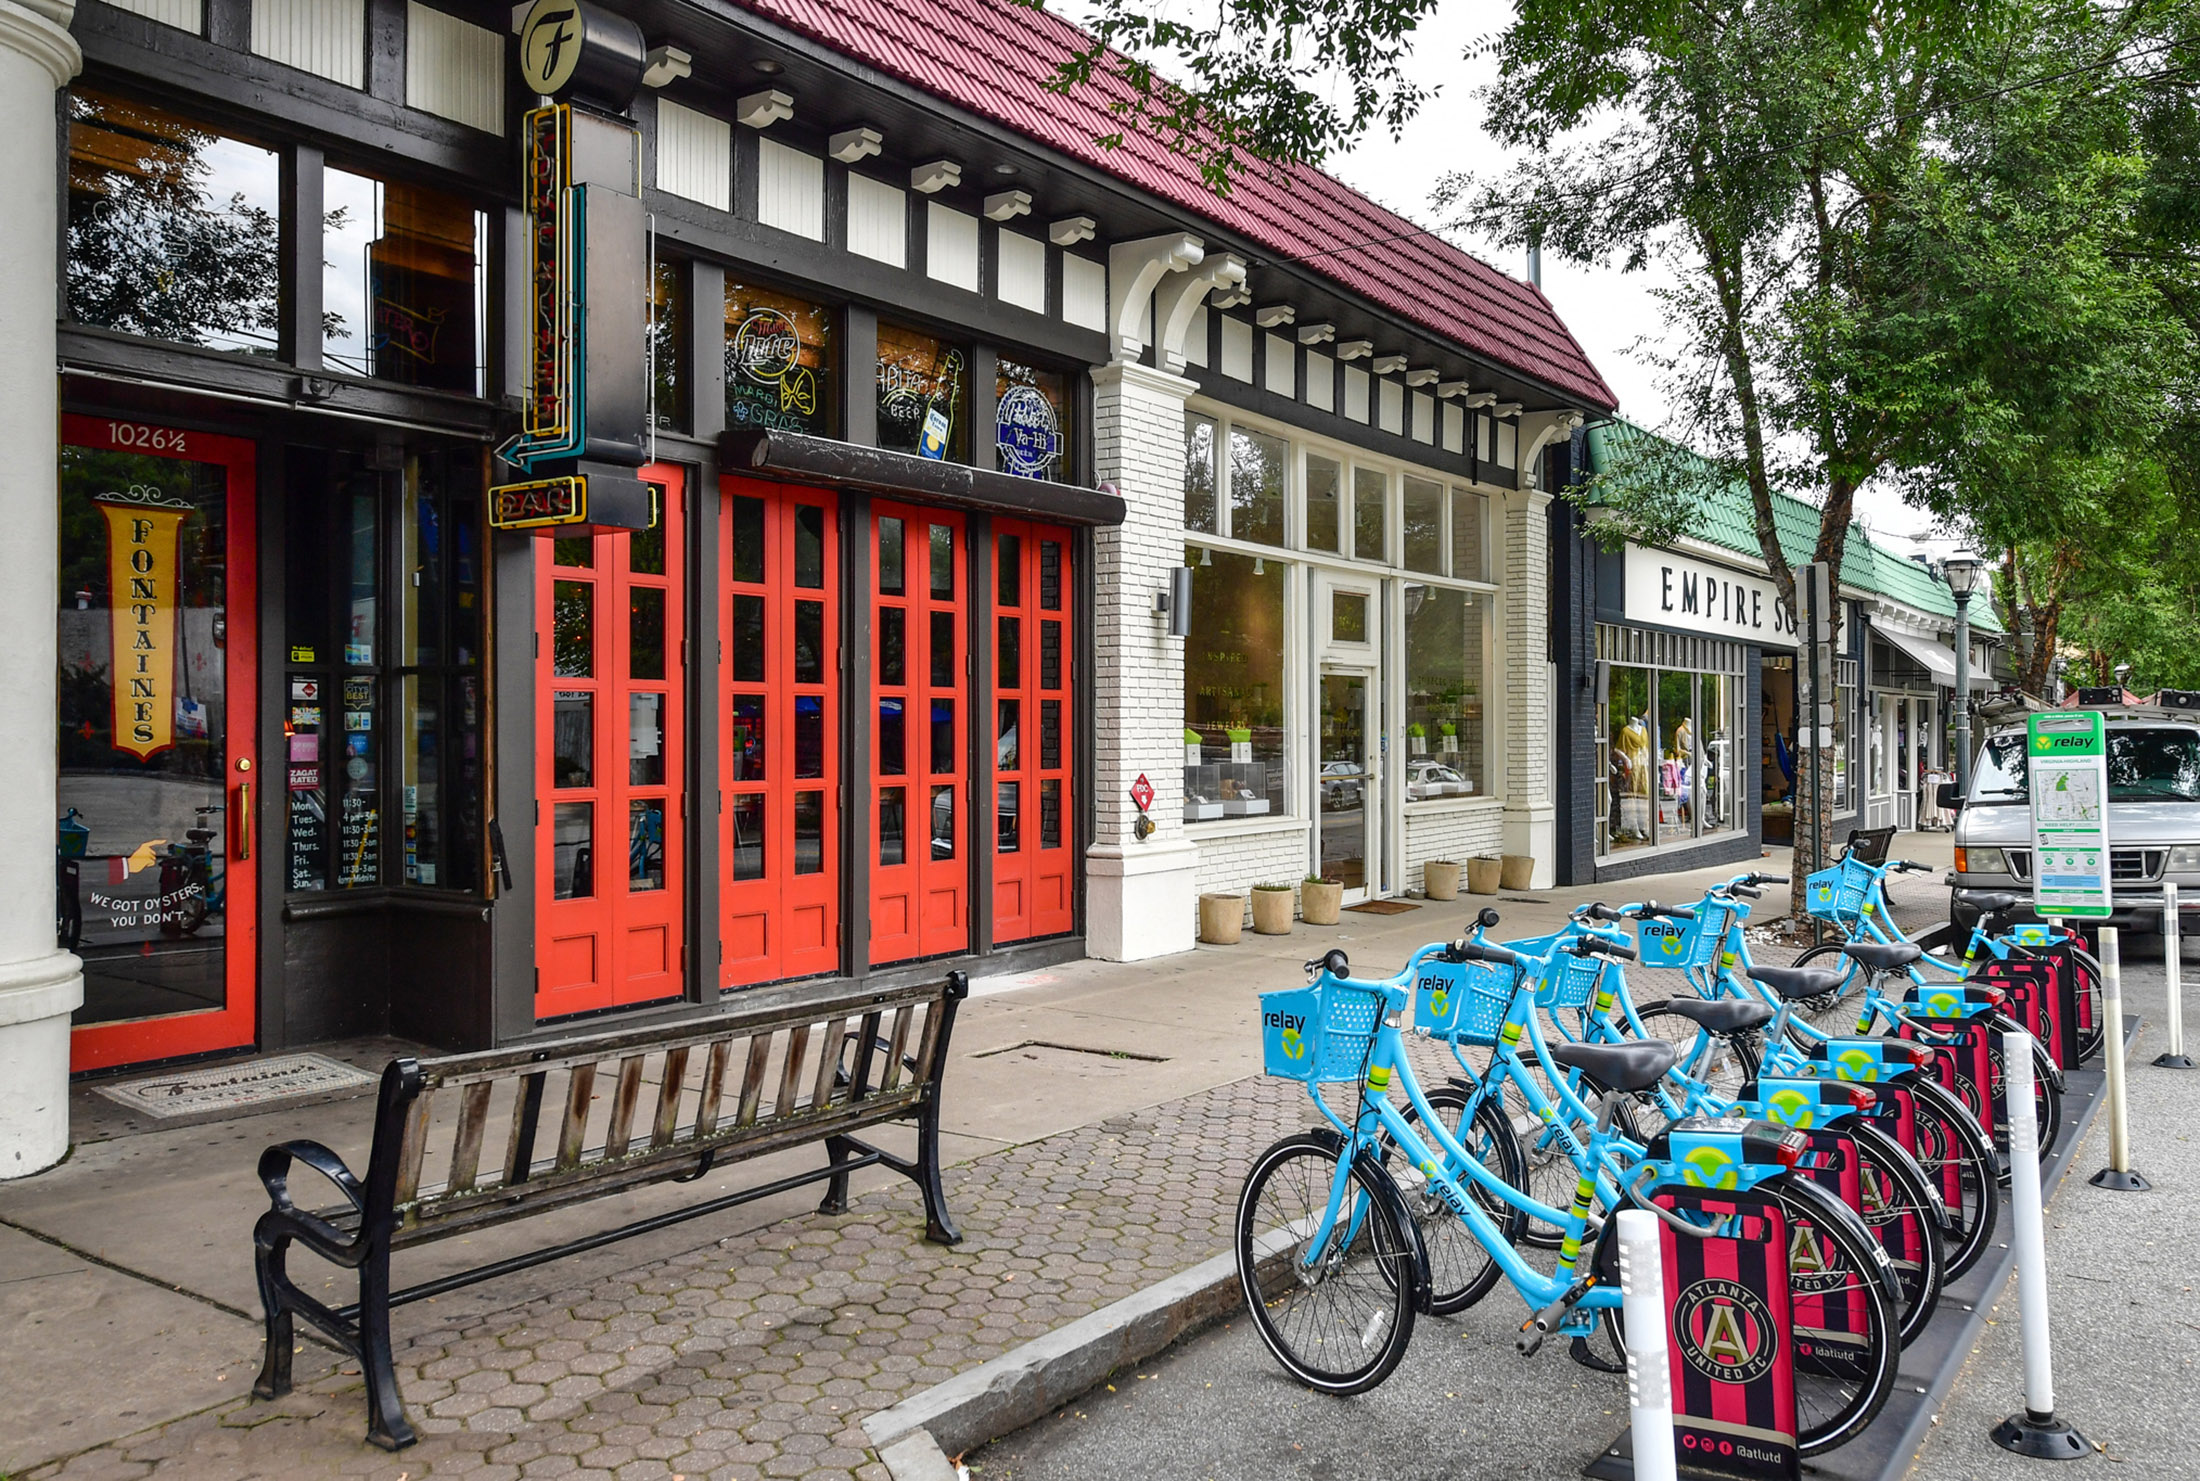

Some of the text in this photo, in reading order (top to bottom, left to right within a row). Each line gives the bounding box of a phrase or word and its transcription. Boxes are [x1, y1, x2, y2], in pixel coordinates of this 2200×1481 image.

[526, 8, 575, 81] F
[740, 334, 796, 366] Lite
[734, 385, 778, 407] MARDI
[750, 403, 804, 435] GRAS
[1013, 428, 1047, 450] Va-Hi
[496, 487, 572, 517] BAR
[1660, 566, 1762, 629] EMPIRE
[130, 519, 157, 744] FONTAINES
[346, 692, 369, 700] BEST
[2054, 736, 2095, 749] relay
[290, 769, 318, 777] ZAGAT
[290, 776, 318, 784] RATED
[1136, 783, 1150, 793] FDC
[292, 815, 317, 825] Tues.
[292, 828, 317, 837] Wed.
[292, 842, 320, 852] Thurs.
[293, 855, 310, 866] Fri.
[292, 868, 312, 879] Sat.
[292, 879, 312, 889] Sun.
[1809, 879, 1834, 890] relay
[90, 892, 111, 908] WE
[111, 899, 140, 912] GOT
[111, 910, 187, 928] YOU DON'T.
[1644, 925, 1686, 940] relay
[1418, 974, 1455, 995] relay
[1264, 1010, 1306, 1034] relay
[1549, 1123, 1580, 1158] relay
[1433, 1179, 1472, 1217] relay
[1791, 1225, 1829, 1274] A
[1686, 1282, 1759, 1312] ATLANTA
[1701, 1303, 1752, 1365] A
[1686, 1346, 1767, 1380] UNITED FC
[1736, 1445, 1782, 1464] @atlutd
